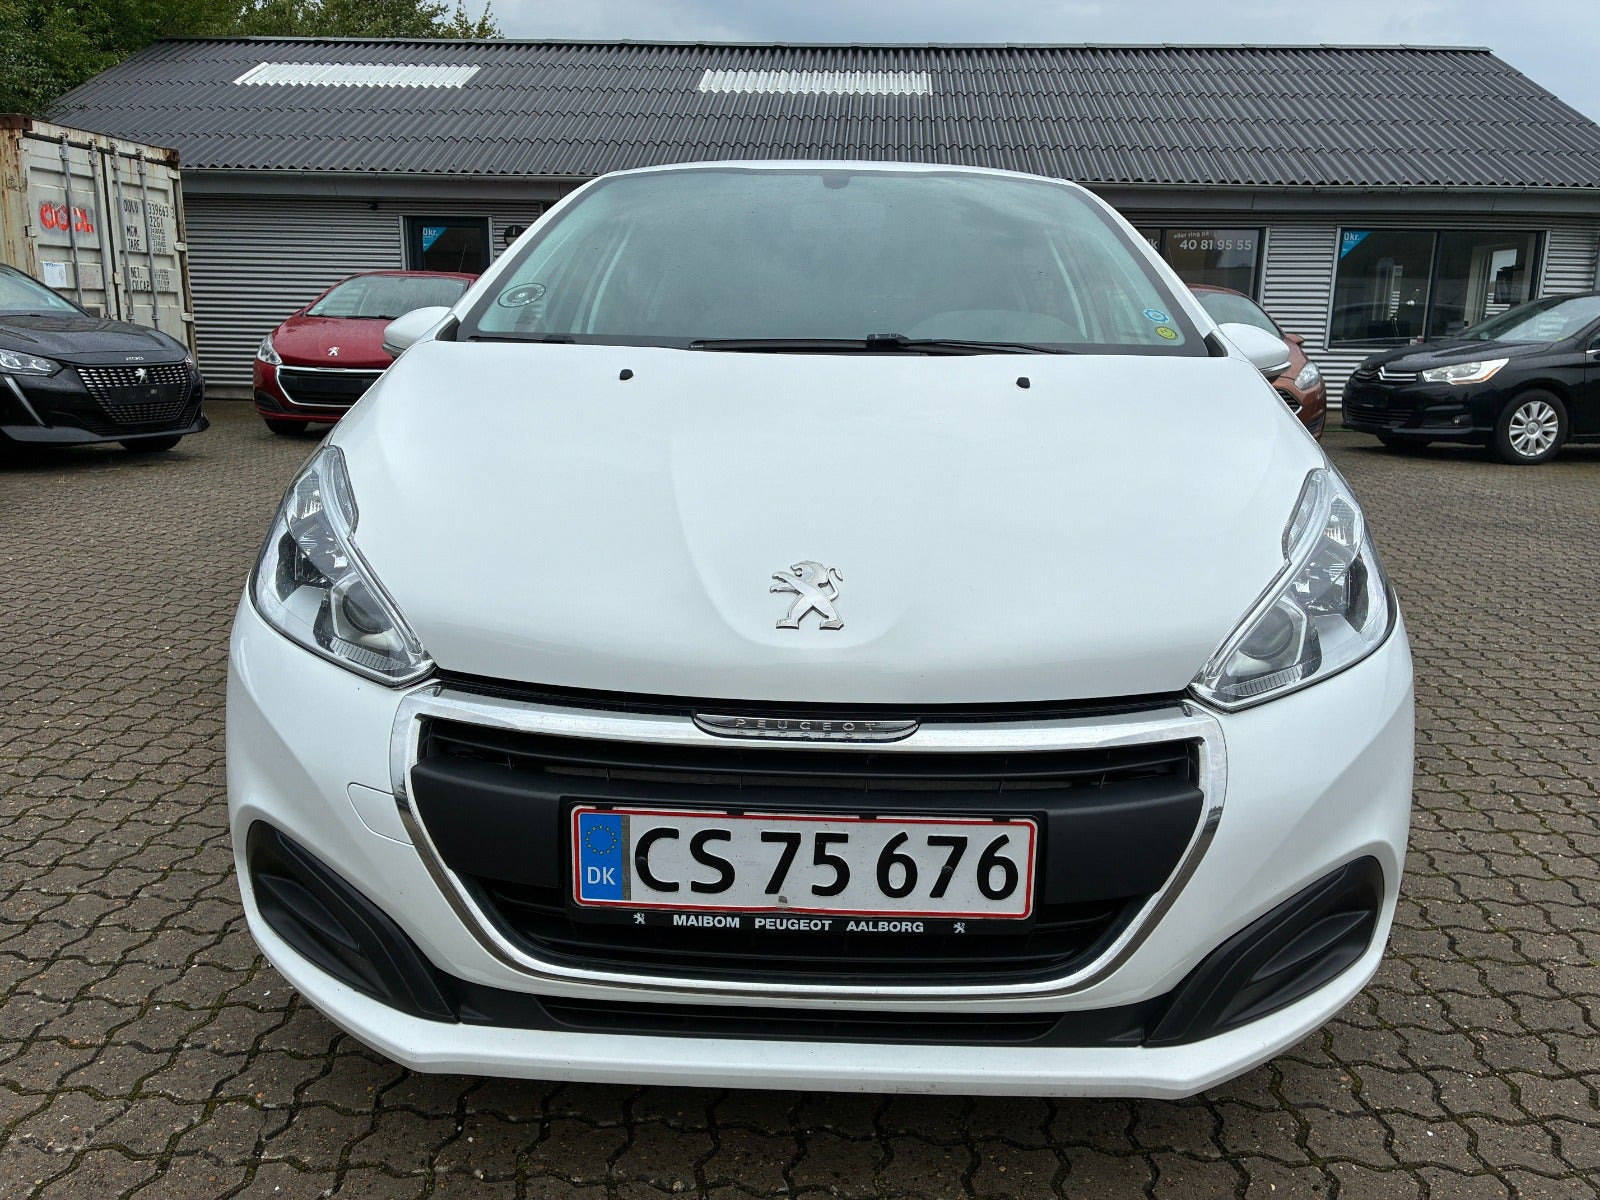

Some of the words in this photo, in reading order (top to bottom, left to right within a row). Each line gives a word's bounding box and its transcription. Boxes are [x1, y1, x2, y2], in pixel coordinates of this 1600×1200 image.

[1173, 231, 1187, 239] eller
[1188, 231, 1200, 239] ring
[1179, 239, 1197, 250] 40
[1200, 239, 1213, 250] 81
[1217, 240, 1232, 250] 95
[1236, 240, 1252, 251] 55
[735, 717, 876, 731] PEUGEOT
[634, 827, 736, 894] CS
[761, 831, 851, 896] 75
[876, 831, 1019, 901] 676
[587, 866, 616, 886] DK
[672, 914, 741, 929] MAIBOM
[754, 918, 833, 932] PEUGEOT
[845, 920, 925, 933] AALBORG
